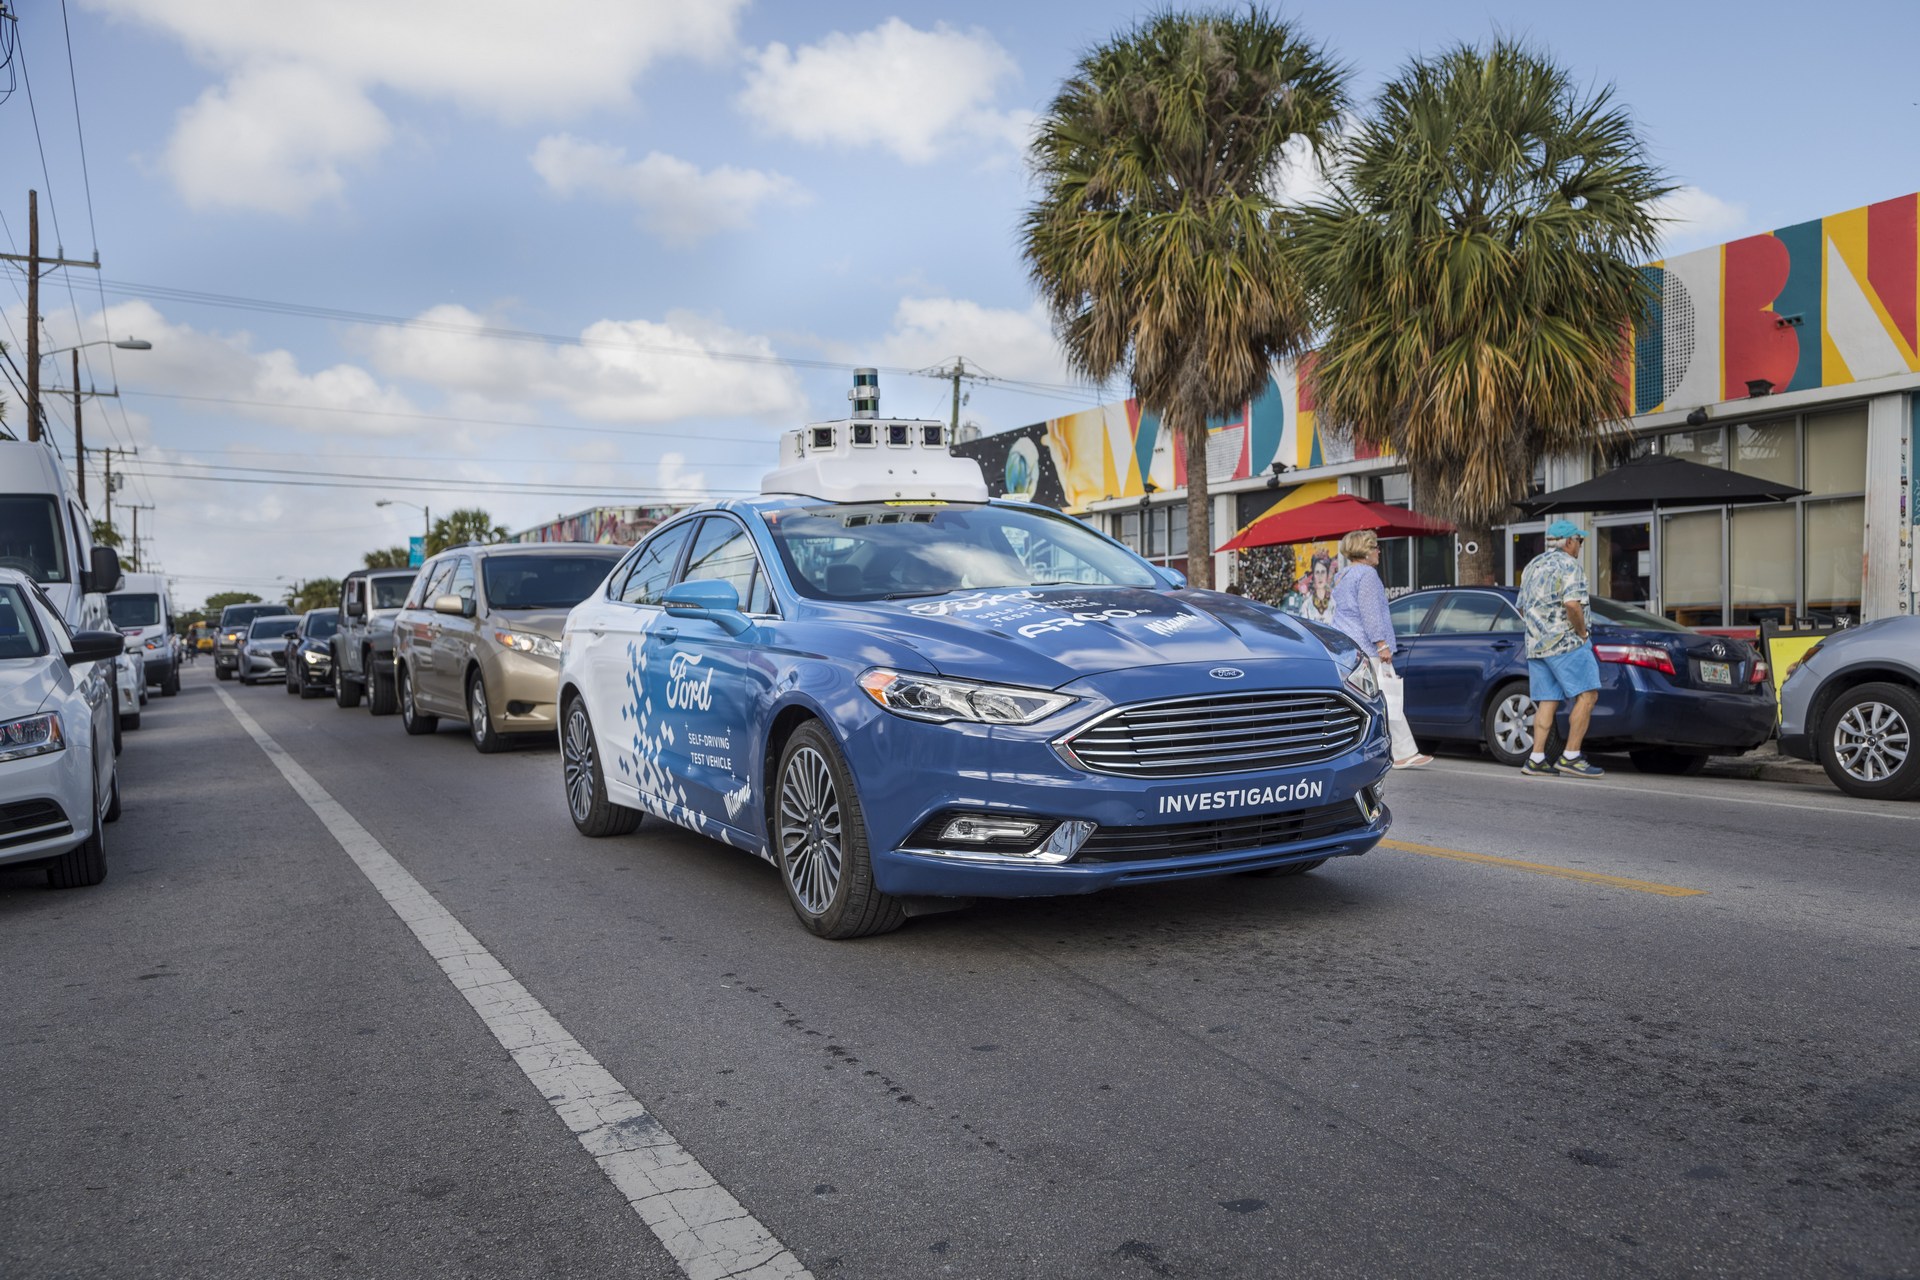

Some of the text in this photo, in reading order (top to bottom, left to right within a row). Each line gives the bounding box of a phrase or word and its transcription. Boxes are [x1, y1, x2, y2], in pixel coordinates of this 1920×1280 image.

[907, 590, 1044, 617] Ford
[990, 611, 1033, 623] TEST
[1017, 609, 1138, 639] ARGO
[1143, 611, 1200, 638] Miami
[666, 651, 714, 712] Ford
[688, 732, 730, 750] SELF-DRIVING
[690, 751, 732, 770] TEST VEHICLE
[723, 774, 752, 820] Miami
[1158, 778, 1323, 814] INVESTIGACIÓN
